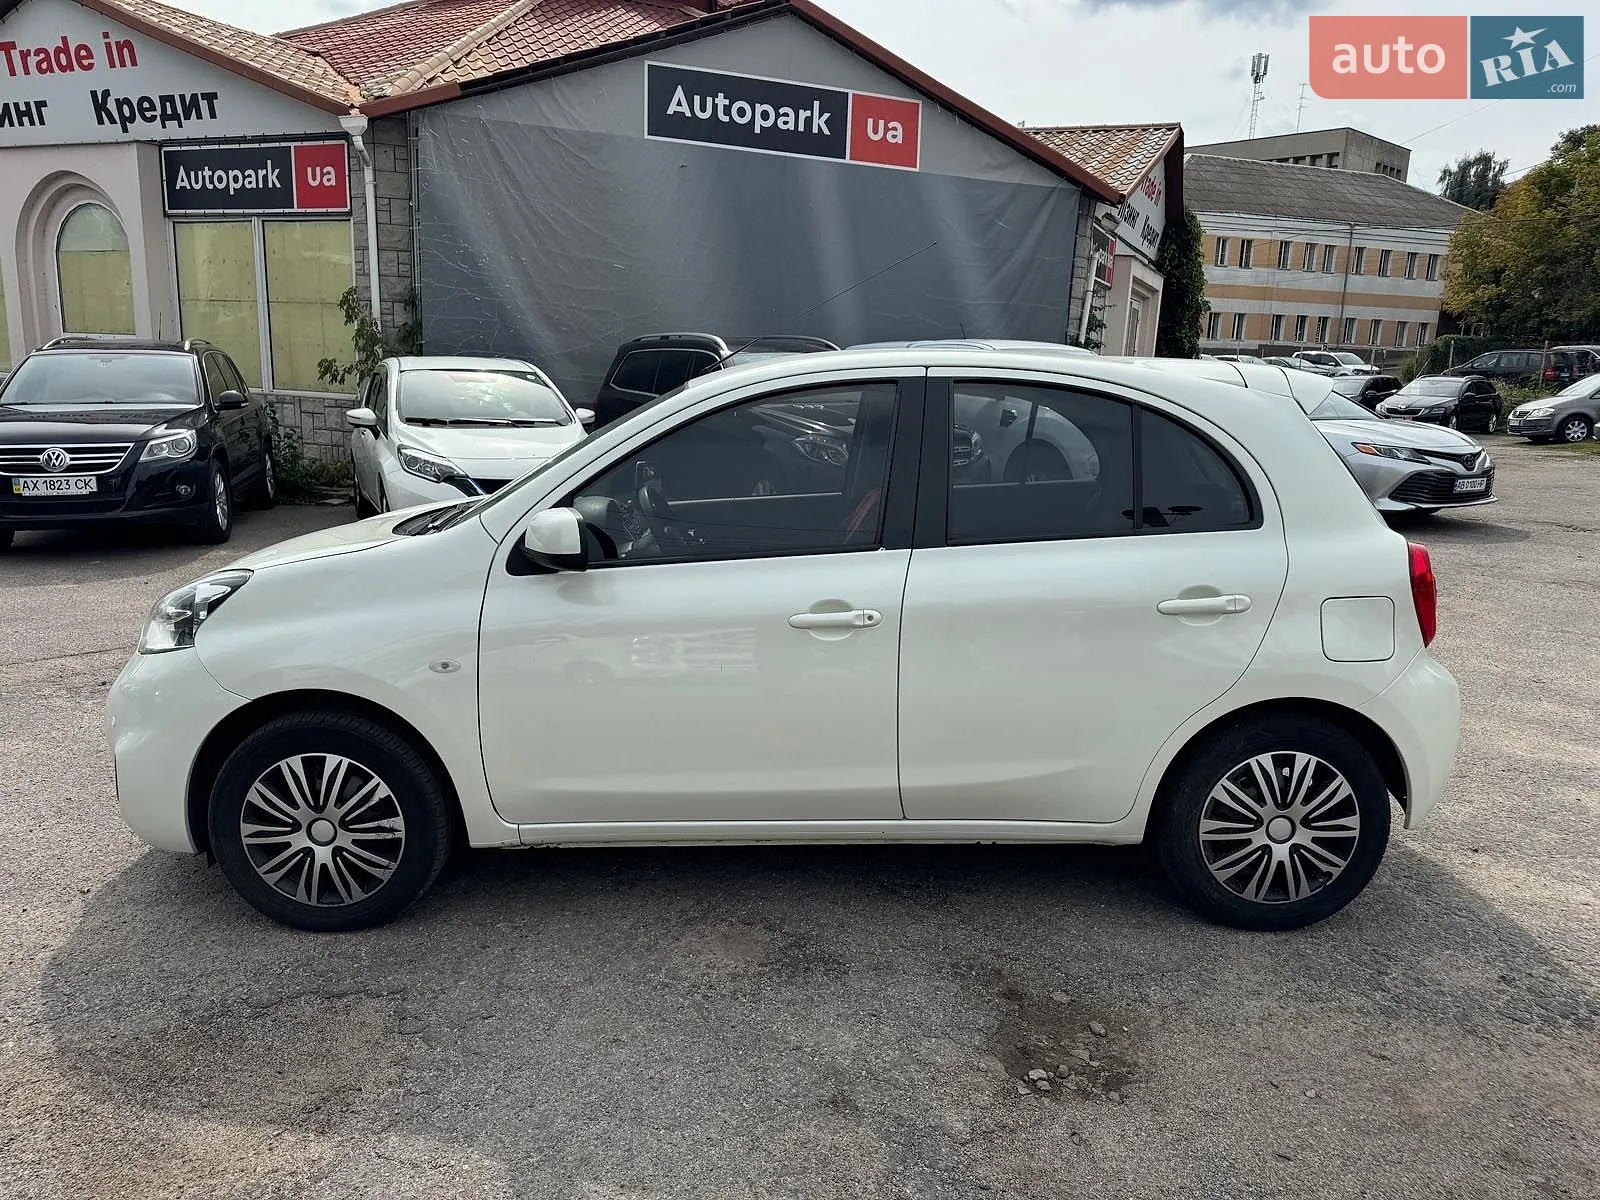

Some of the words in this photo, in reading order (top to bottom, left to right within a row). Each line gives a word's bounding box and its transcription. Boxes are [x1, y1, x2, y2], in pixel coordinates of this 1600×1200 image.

[0, 36, 95, 77] Trade
[102, 32, 138, 69] in
[89, 88, 219, 134] Кредит
[666, 84, 831, 135] Autopark
[867, 117, 903, 144] ua
[175, 159, 282, 196] Autopark
[307, 165, 336, 187] ua
[22, 479, 39, 491] AX
[42, 479, 71, 491] 1823
[75, 478, 94, 490] CK
